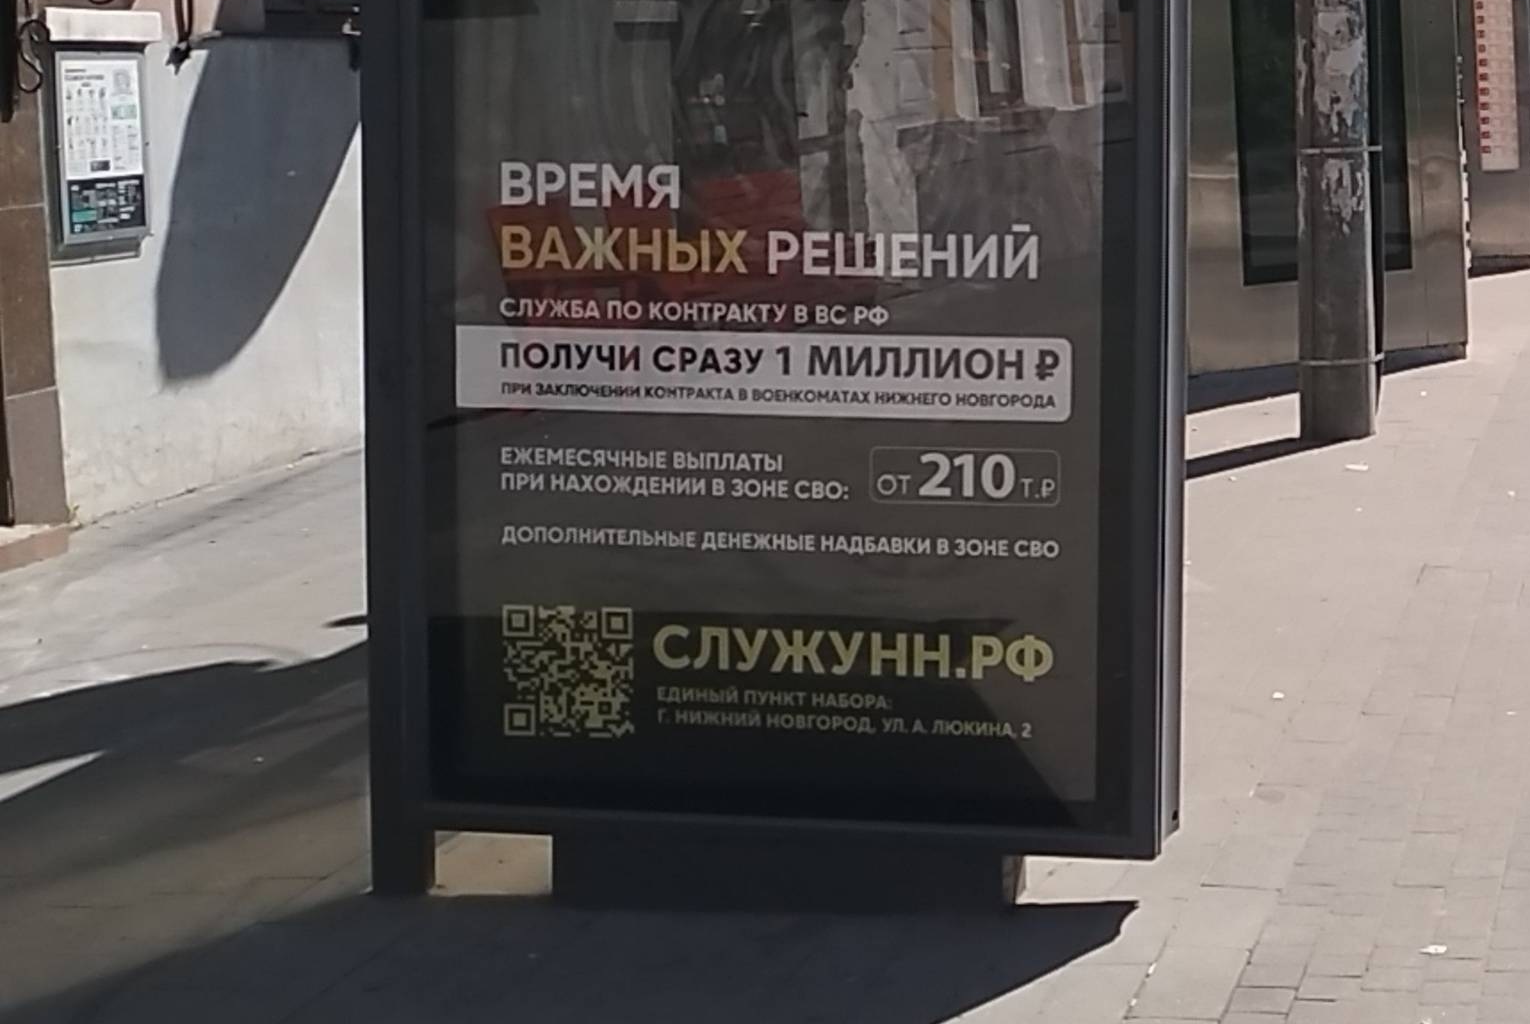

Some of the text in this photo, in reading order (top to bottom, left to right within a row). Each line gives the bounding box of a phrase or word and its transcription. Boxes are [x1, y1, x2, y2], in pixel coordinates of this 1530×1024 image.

[500, 161, 680, 209] ВРЕМЯ
[500, 223, 1039, 279] ВАЖНЫХ РЕШЕНИЙ
[500, 298, 890, 326] СЛУЖБА ПО КОНТРАКТУ В ВС РФ
[500, 342, 641, 371] ПОЛУЧИ
[652, 345, 764, 375] СРАЗУ
[775, 345, 791, 376] 1
[808, 345, 1024, 381] МИЛЛИОН
[501, 382, 1056, 410] ПРИ ЗАКЛЮЧЕНИИ КОНТРАКТА В ВОЕНКОМАТАХ НИЖНЕГО НОВГОРОДА
[501, 447, 783, 473] ЕЖЕМЕСЯЧНЫЕ ВЫПЛАТЫ
[876, 474, 912, 496] ОТ
[918, 451, 1016, 499] 210
[501, 472, 850, 500] ПРИ НАХОЖДЕНИИ В ЗОНЕ СВО:
[501, 525, 1061, 559] ДОПОЛНИТЕЛЬНЫЕ ДЕНЕЖНЫЕ НАДБАВКИ В ЗОНЕ СВО
[652, 624, 1055, 682] СЛУЖУНН.РФ
[656, 685, 893, 710] ЕДИНЫЙ ПУНКТ НАБОРА:
[674, 709, 762, 727] НИЖНИЙ
[1021, 722, 1033, 739] 2
